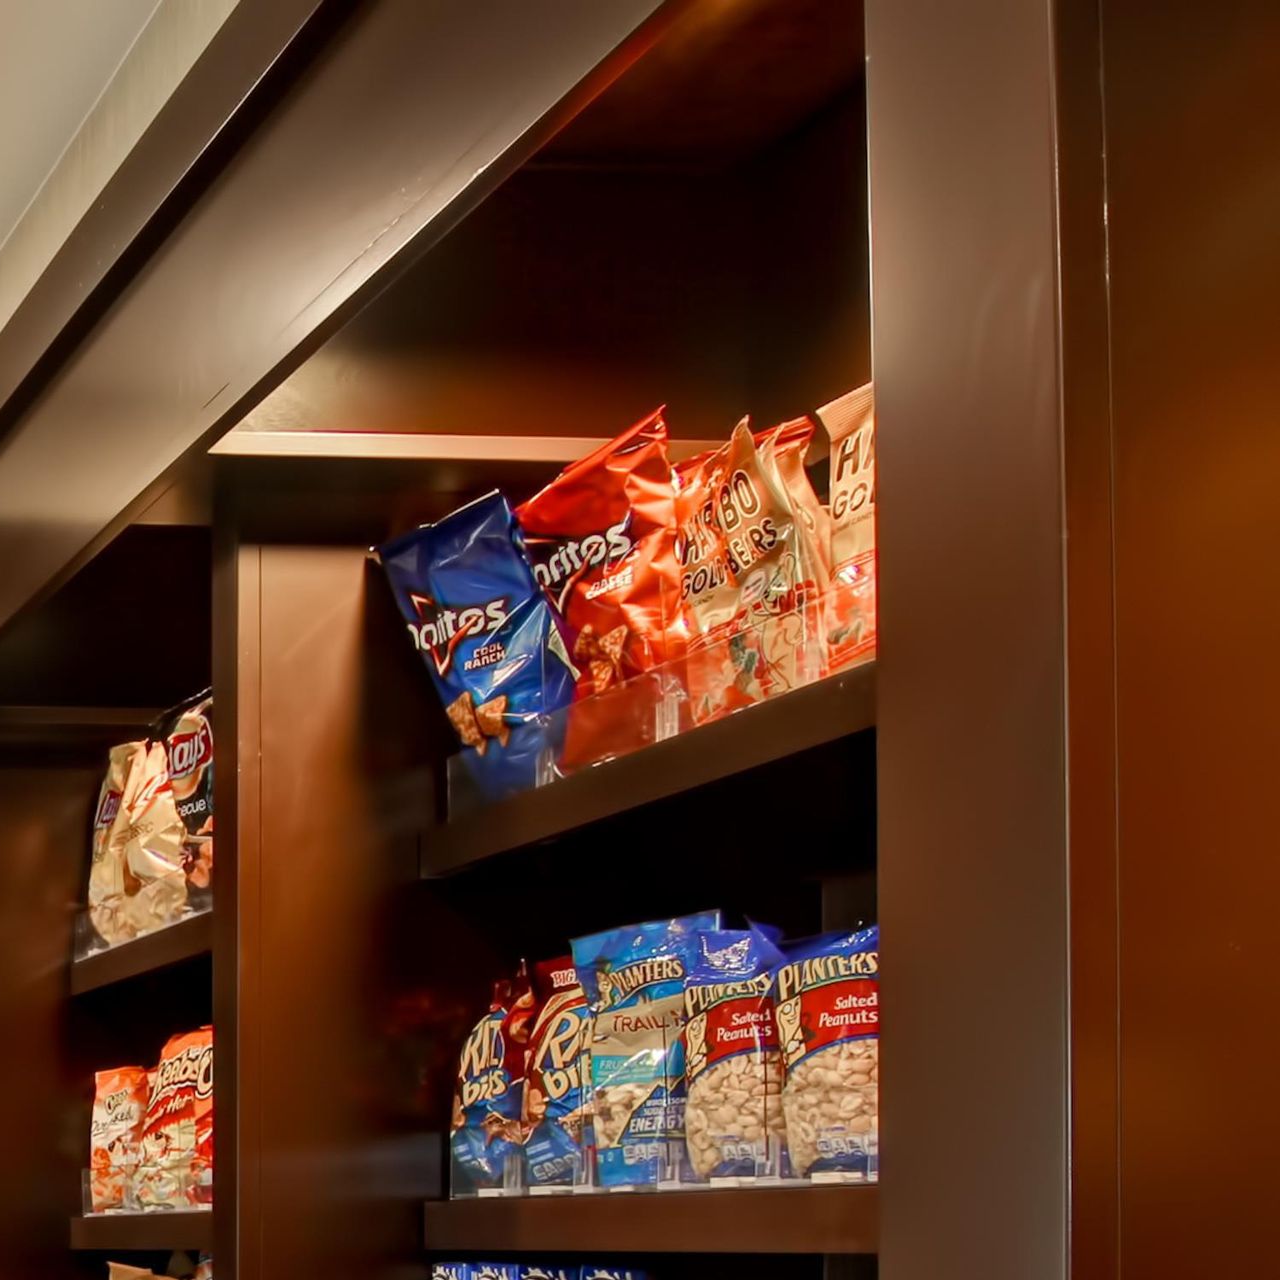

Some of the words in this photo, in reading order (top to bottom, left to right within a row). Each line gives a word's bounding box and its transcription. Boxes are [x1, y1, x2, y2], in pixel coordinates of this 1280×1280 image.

[534, 523, 632, 587] oritos
[473, 642, 504, 658] COOL
[464, 650, 506, 671] RANCH
[552, 970, 576, 987] BIG
[612, 958, 684, 998] PLANTERS
[778, 952, 879, 1000] PLANTERS
[834, 992, 878, 1011] Salted
[613, 1013, 666, 1033] TRAIL
[731, 1009, 771, 1026] Salted
[818, 1010, 878, 1028] Peanuts
[716, 1023, 772, 1042] Peanuts
